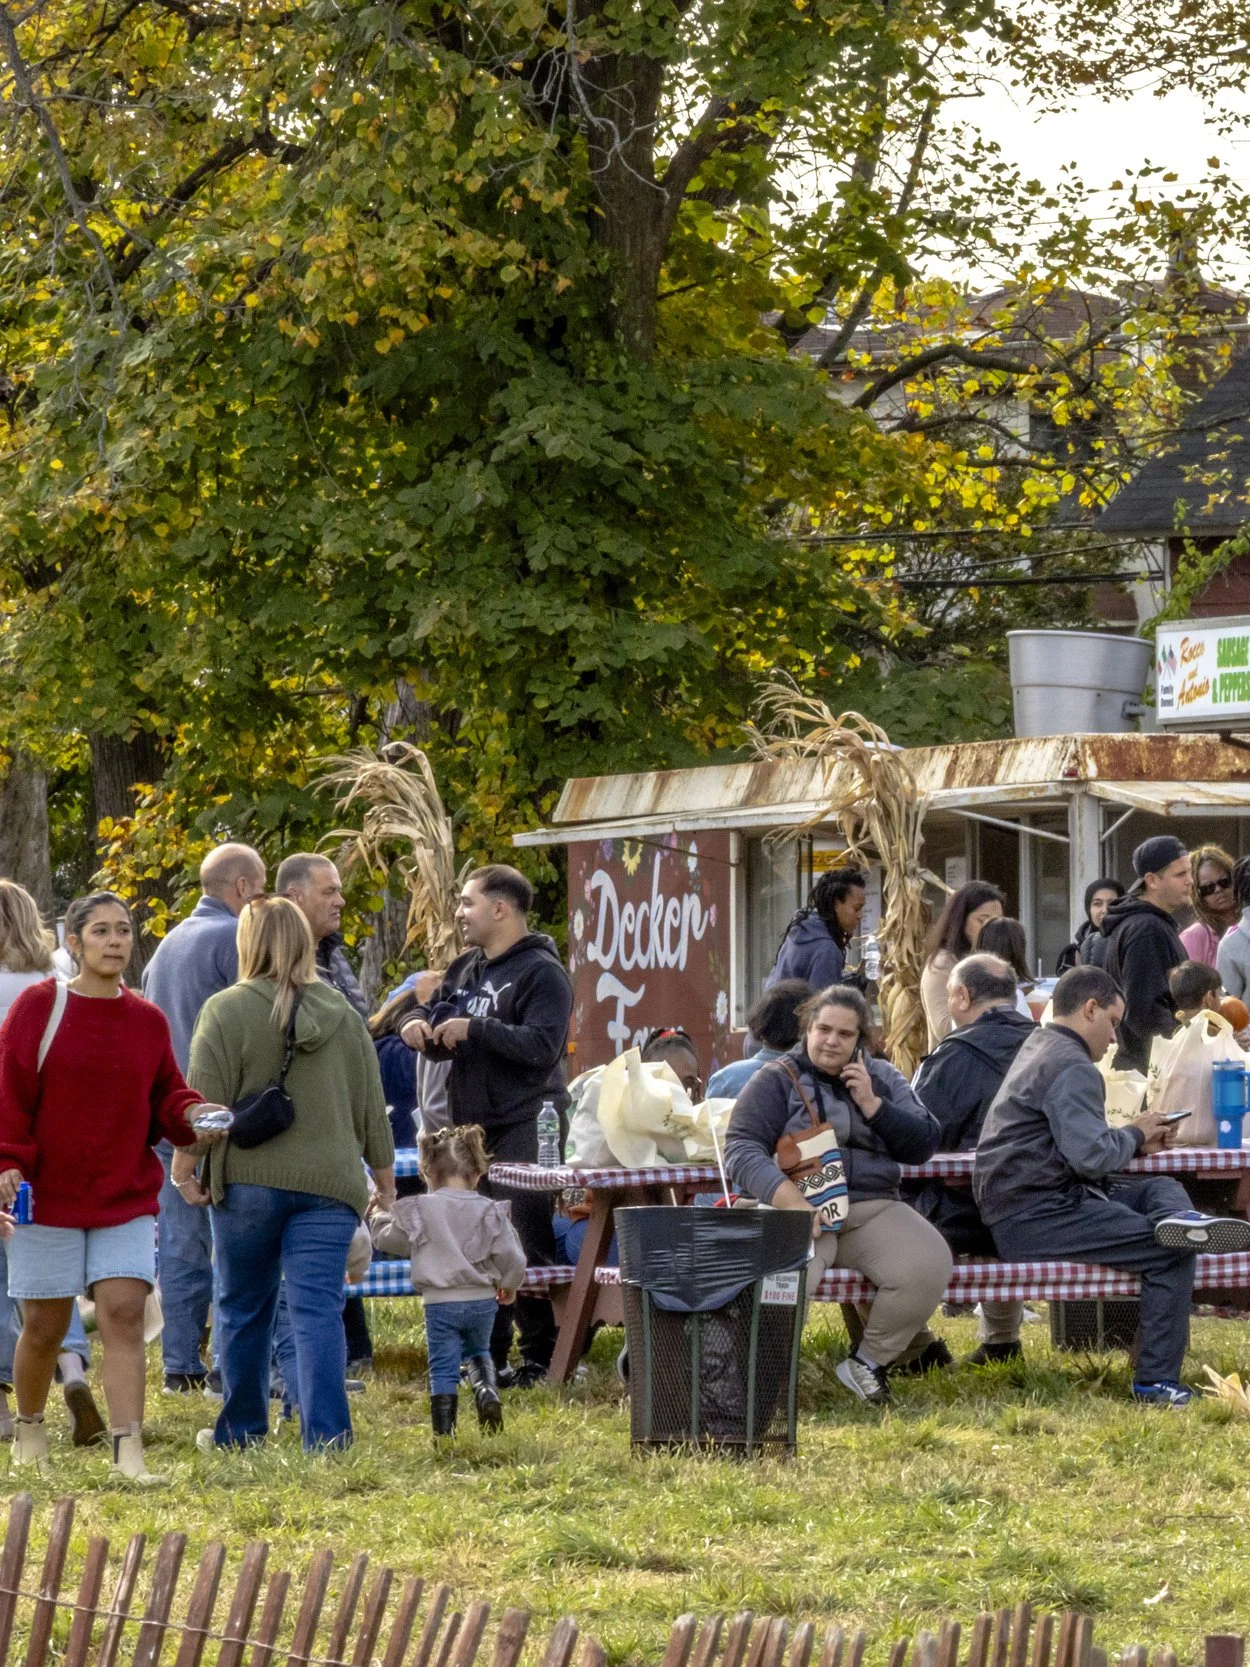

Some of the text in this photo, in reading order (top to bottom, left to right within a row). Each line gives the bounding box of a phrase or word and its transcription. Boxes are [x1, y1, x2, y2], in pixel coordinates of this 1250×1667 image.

[1180, 636, 1206, 668] Rocco
[1217, 635, 1250, 669] SAUSAGE
[1187, 661, 1199, 681] and
[1176, 675, 1211, 711] Antonio
[1212, 677, 1218, 704] &
[587, 851, 709, 972] Decker
